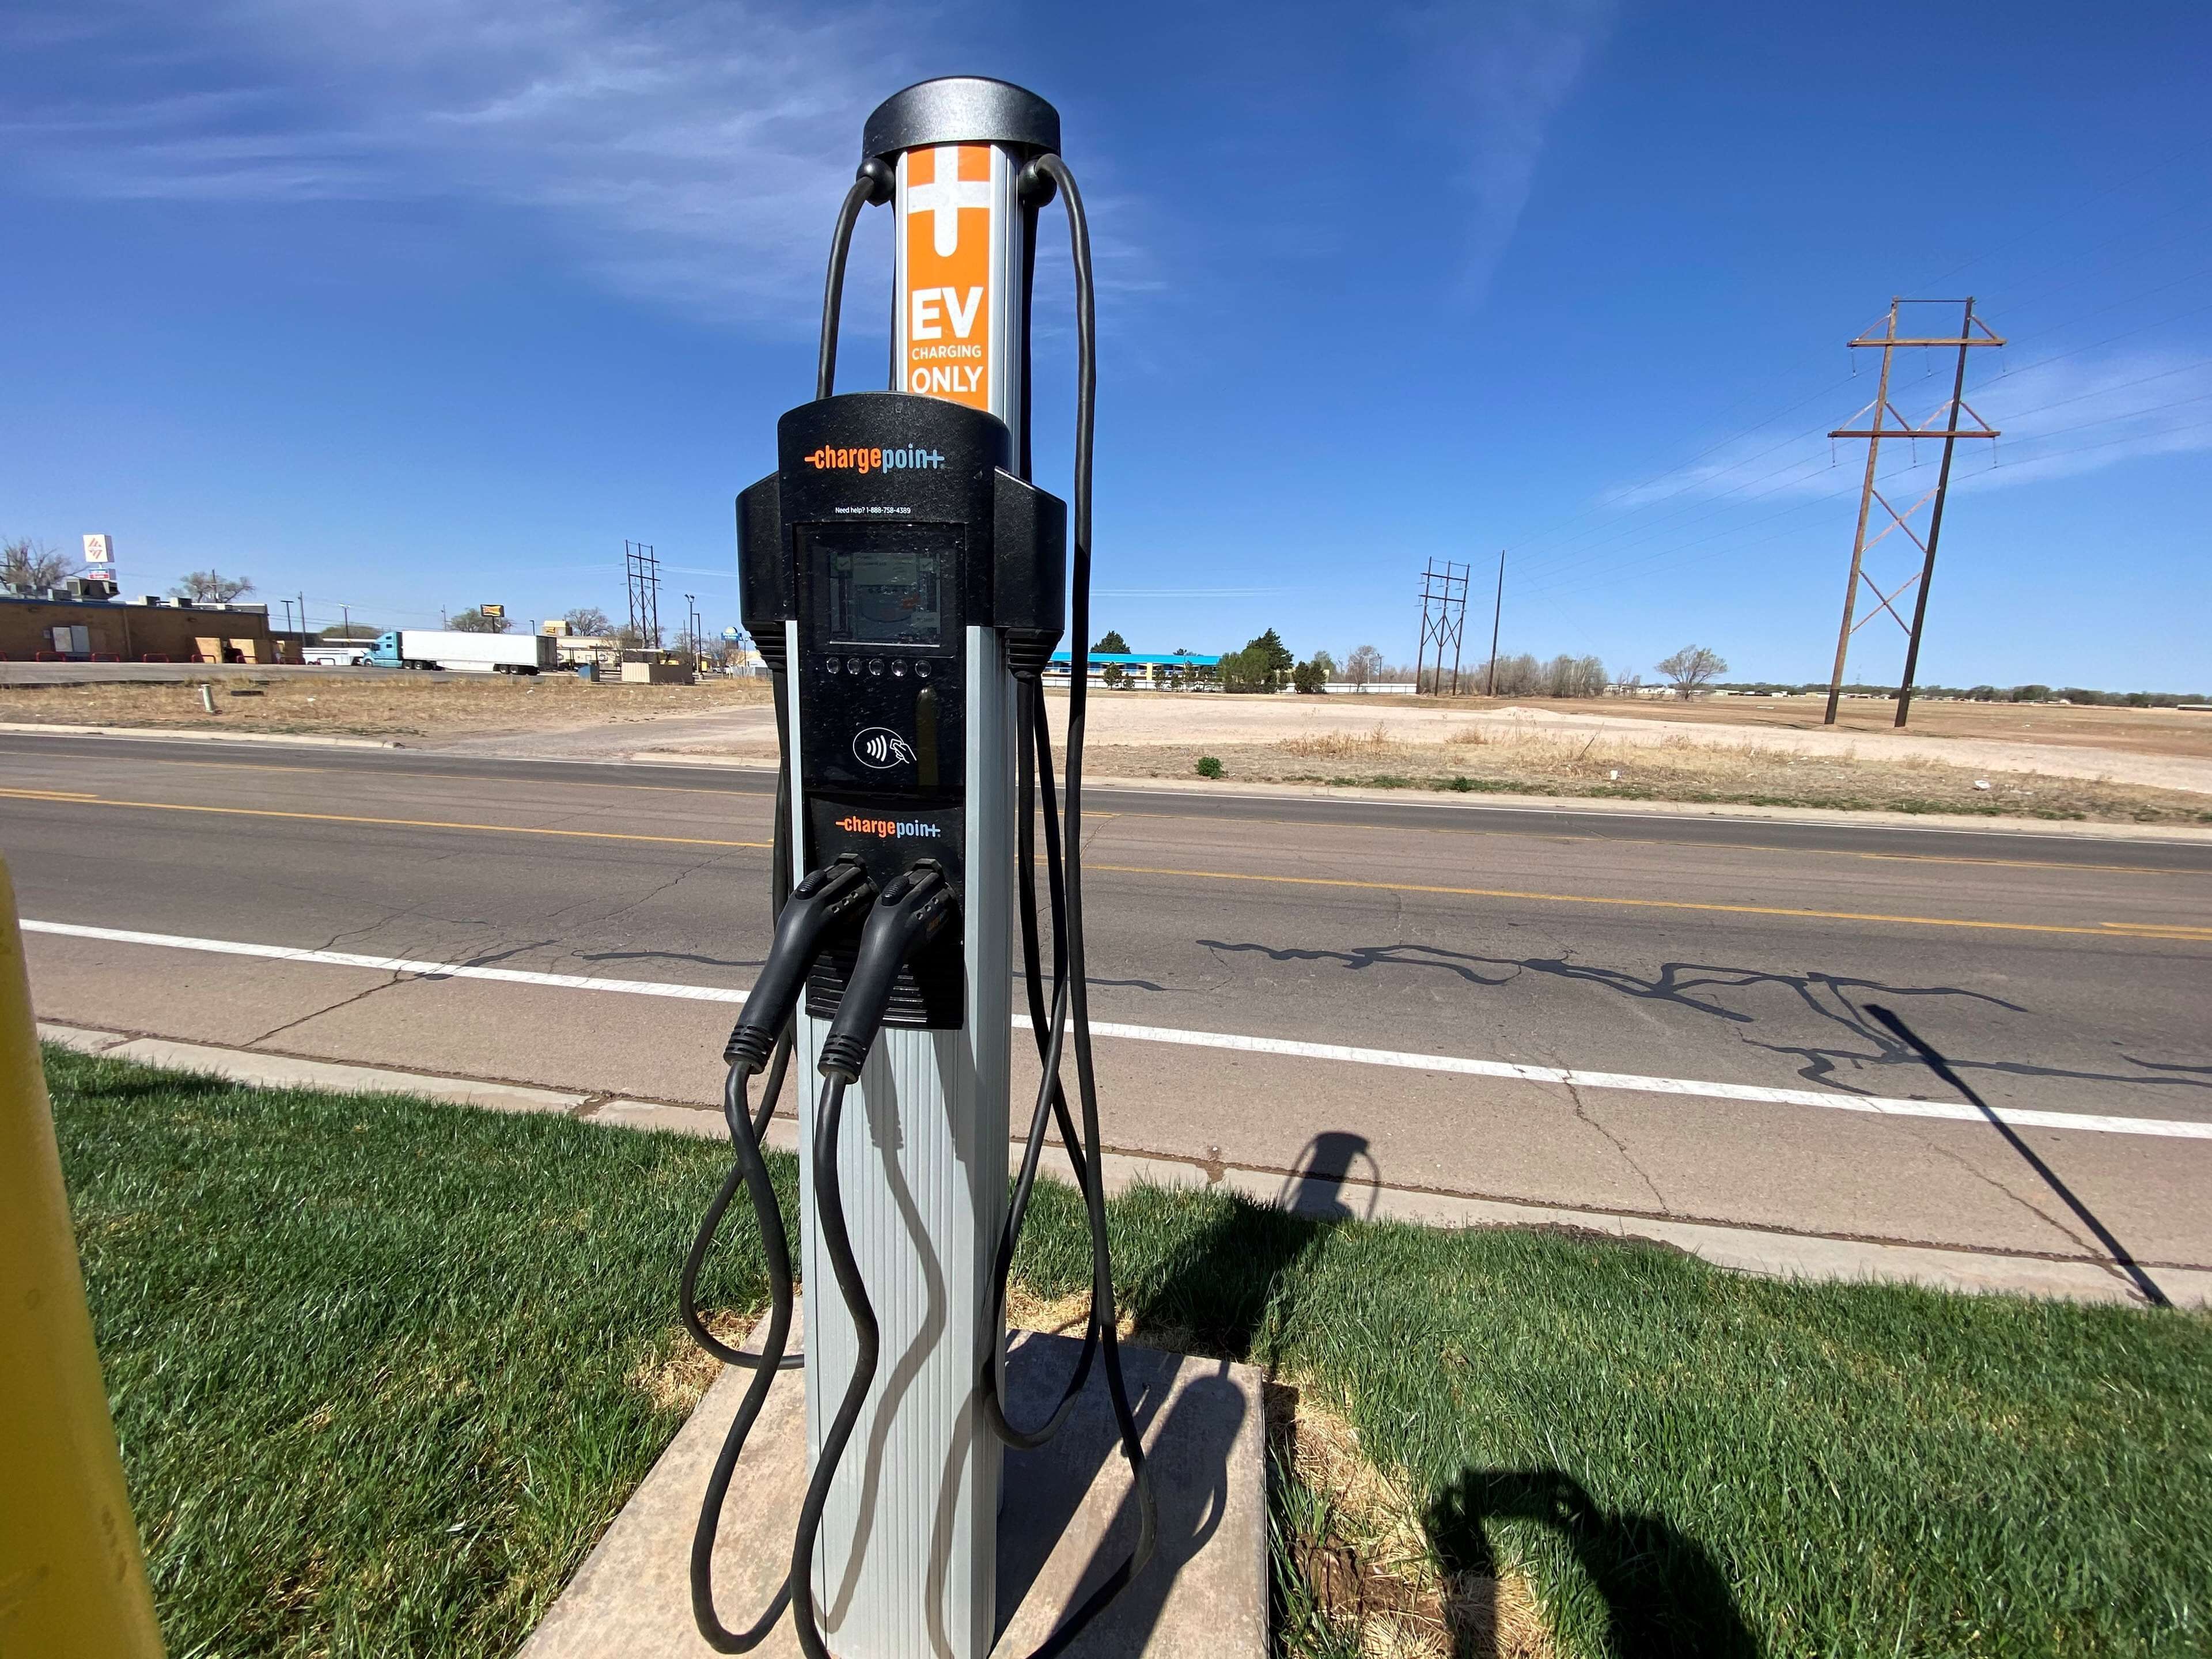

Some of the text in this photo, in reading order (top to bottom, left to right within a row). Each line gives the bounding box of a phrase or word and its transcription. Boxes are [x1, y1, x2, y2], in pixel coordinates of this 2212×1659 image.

[912, 287, 984, 341] EV
[912, 344, 982, 361] CHARGING
[911, 366, 984, 394] ONLY
